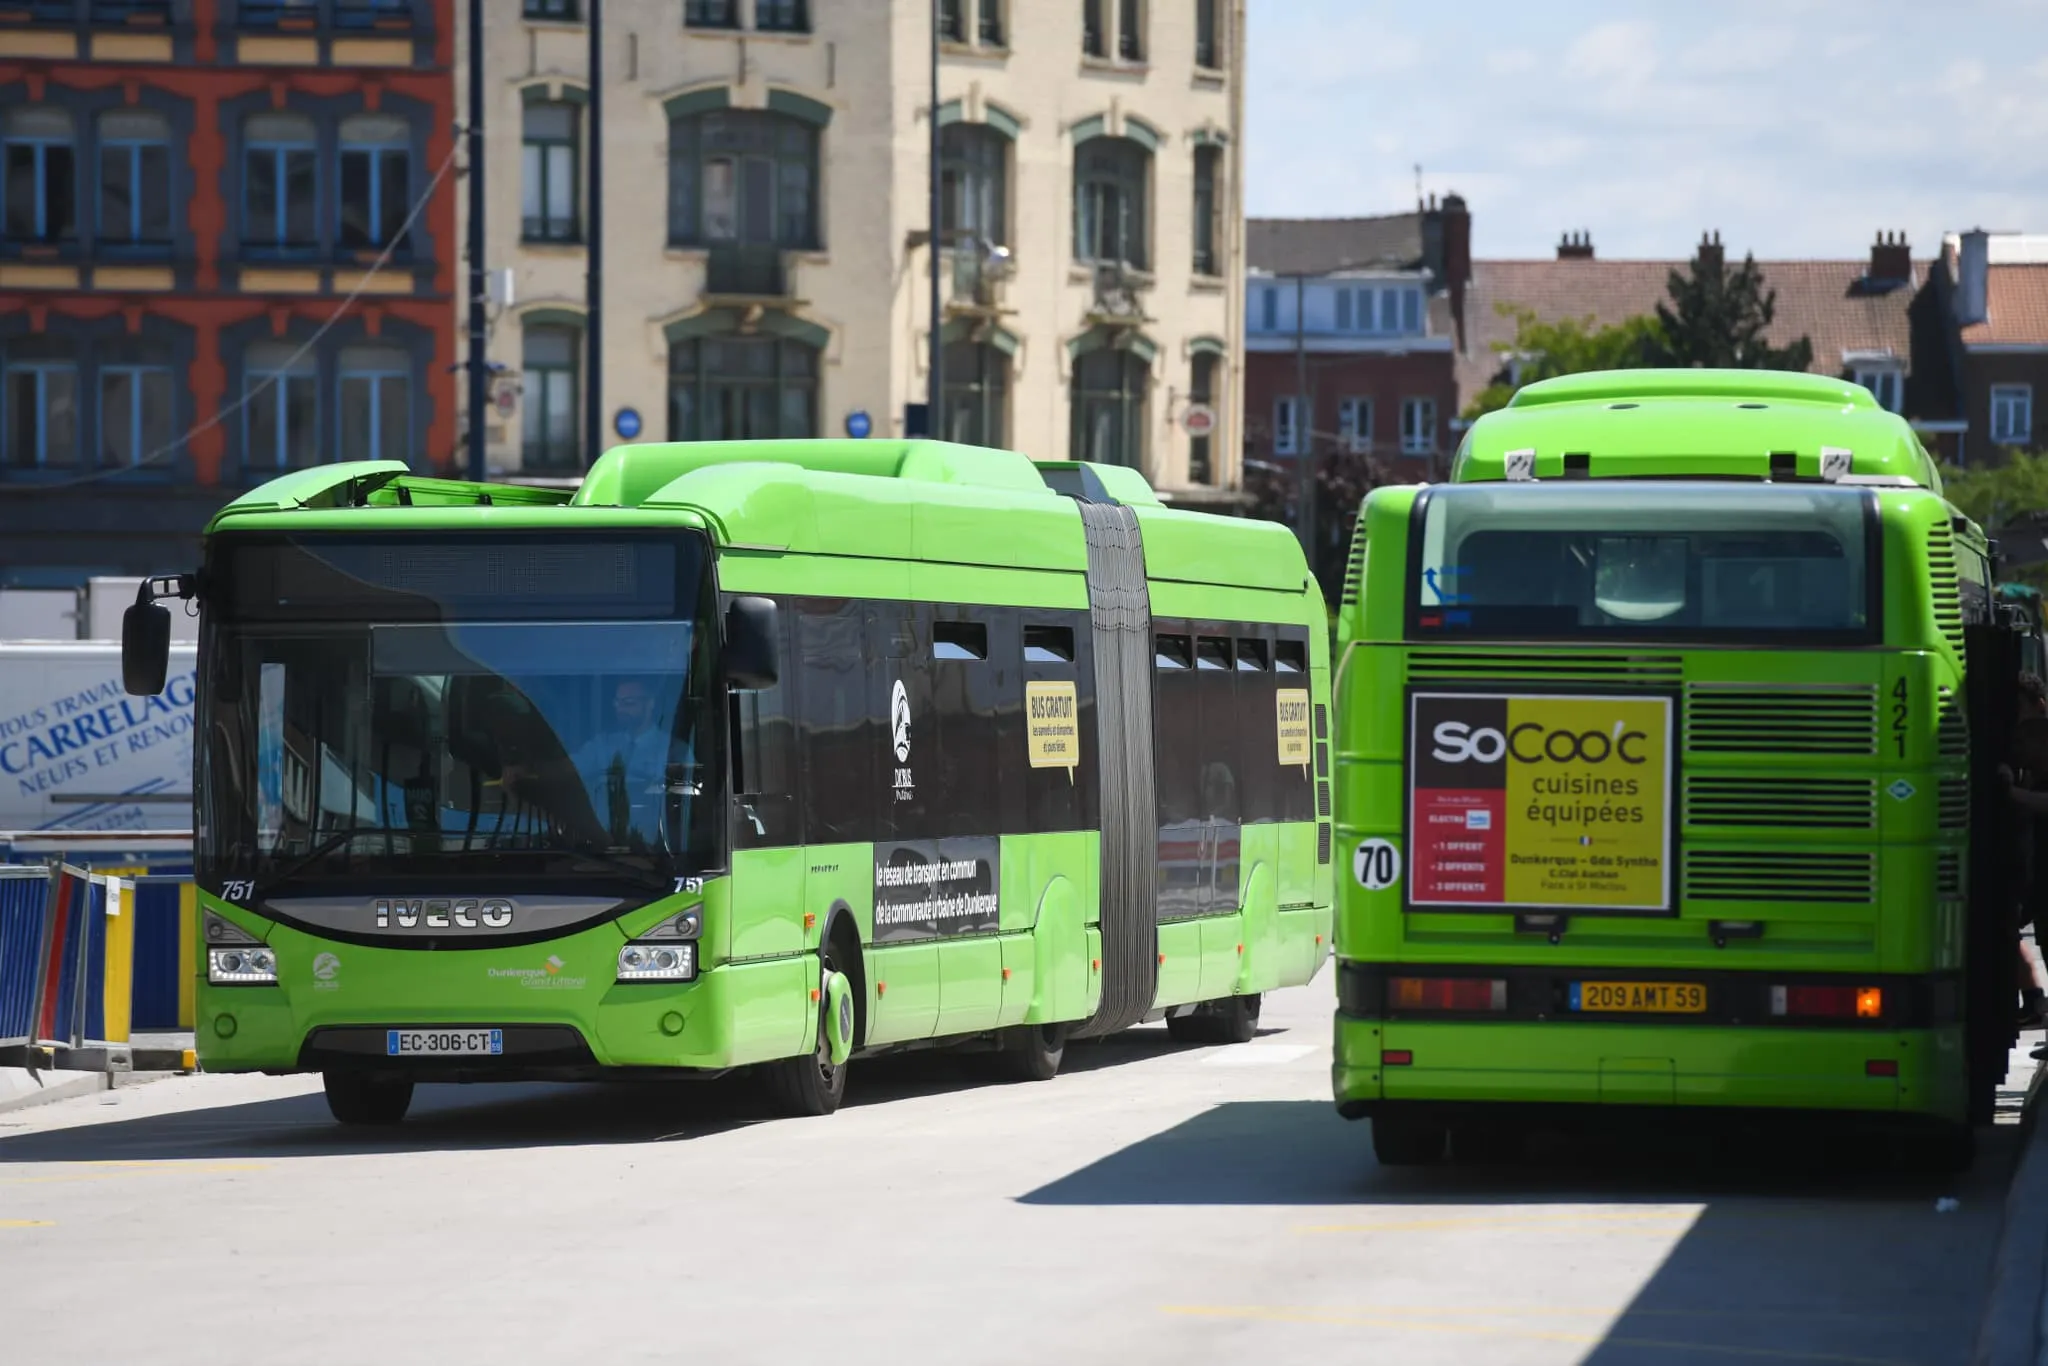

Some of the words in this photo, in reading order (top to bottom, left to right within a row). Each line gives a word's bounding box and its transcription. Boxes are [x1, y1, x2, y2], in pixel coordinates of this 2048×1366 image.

[1032, 696, 1045, 718] BUS
[1046, 696, 1072, 718] GRATUIT
[0, 670, 197, 775] CARRELAG
[18, 754, 89, 798] NEUFS
[94, 740, 120, 767] ET
[1532, 772, 1639, 795] cuisines
[1526, 798, 1643, 827] équipées
[1360, 845, 1393, 884] 70
[1511, 854, 1577, 866] Dunkerque
[674, 876, 703, 896] 751
[884, 860, 904, 887] réseau
[904, 860, 912, 885] de
[913, 859, 941, 888] transport
[942, 862, 950, 881] en
[950, 859, 977, 881] commun
[221, 880, 255, 900] 751
[376, 899, 513, 928] IVECO
[876, 900, 884, 925] de
[885, 899, 891, 924] la
[892, 894, 932, 923] communauté
[932, 893, 956, 919] urbaine
[956, 892, 964, 917] de
[964, 889, 997, 917] Dunkerque
[488, 967, 546, 979] Dunkerque
[1587, 986, 1626, 1007] 209
[1631, 986, 1669, 1008] AMT
[1675, 986, 1700, 1008] 59
